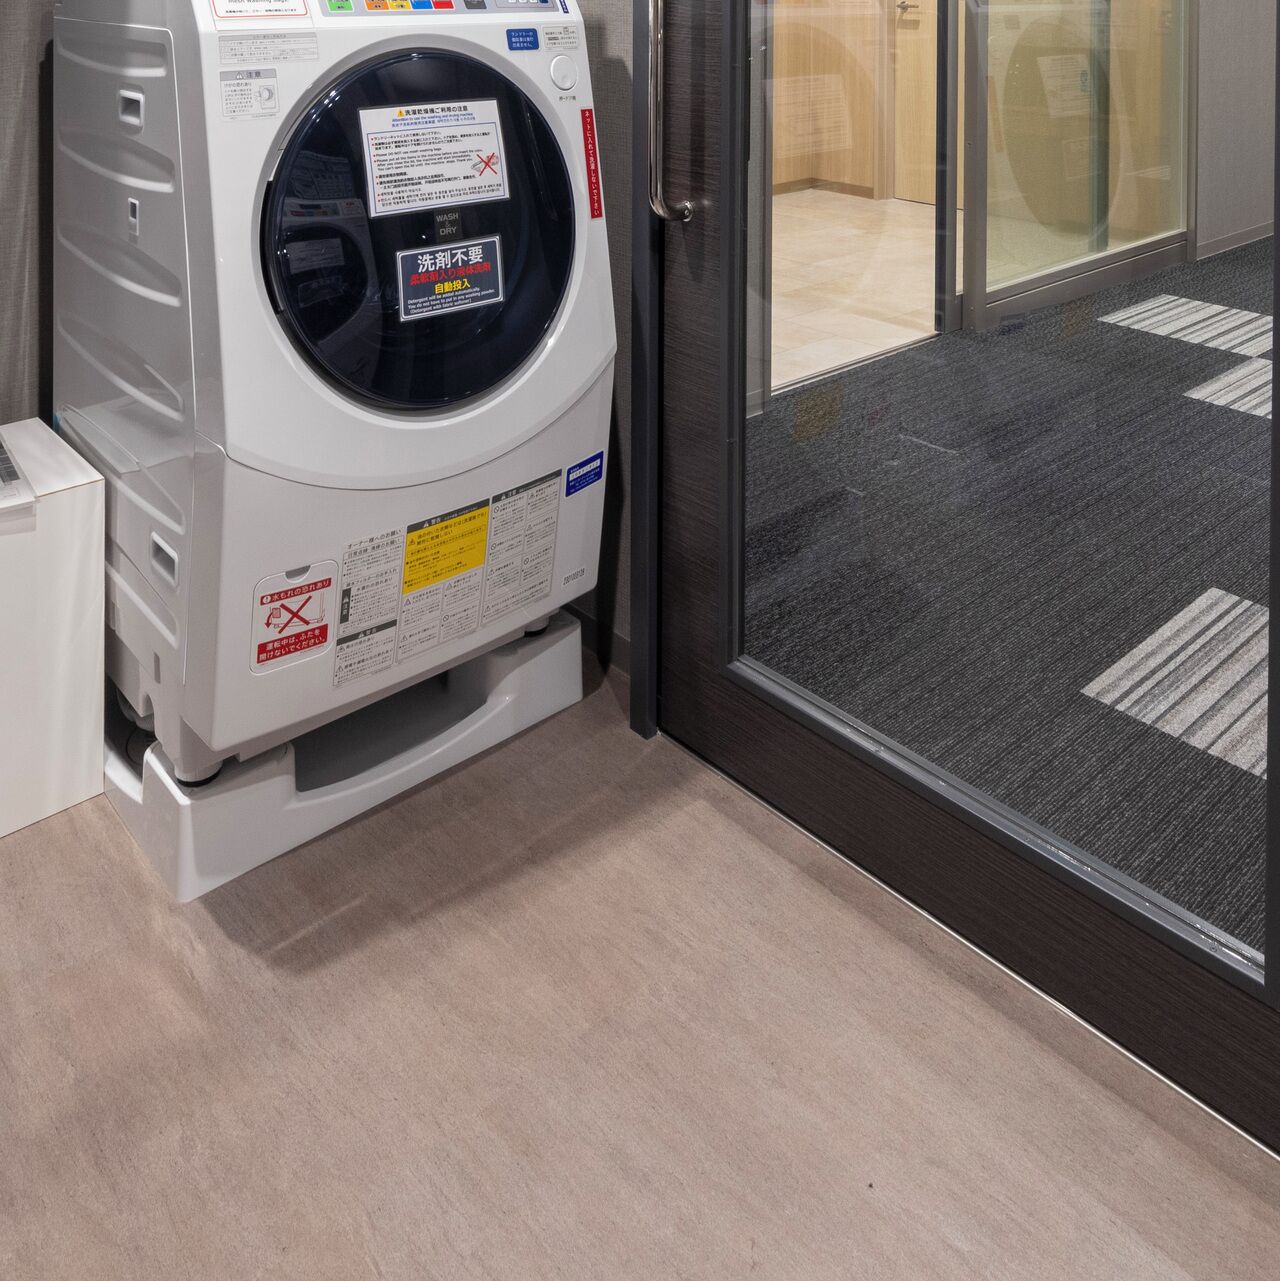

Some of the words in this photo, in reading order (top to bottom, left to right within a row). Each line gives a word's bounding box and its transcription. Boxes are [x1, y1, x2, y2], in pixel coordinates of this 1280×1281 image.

[436, 212, 459, 222] WASH
[439, 226, 457, 236] DRY
[417, 245, 483, 273] 洗剤不要
[434, 280, 470, 294] 自動投入
[272, 580, 329, 601] 水もれの恐れあり
[259, 636, 325, 660] 開けないでください。
